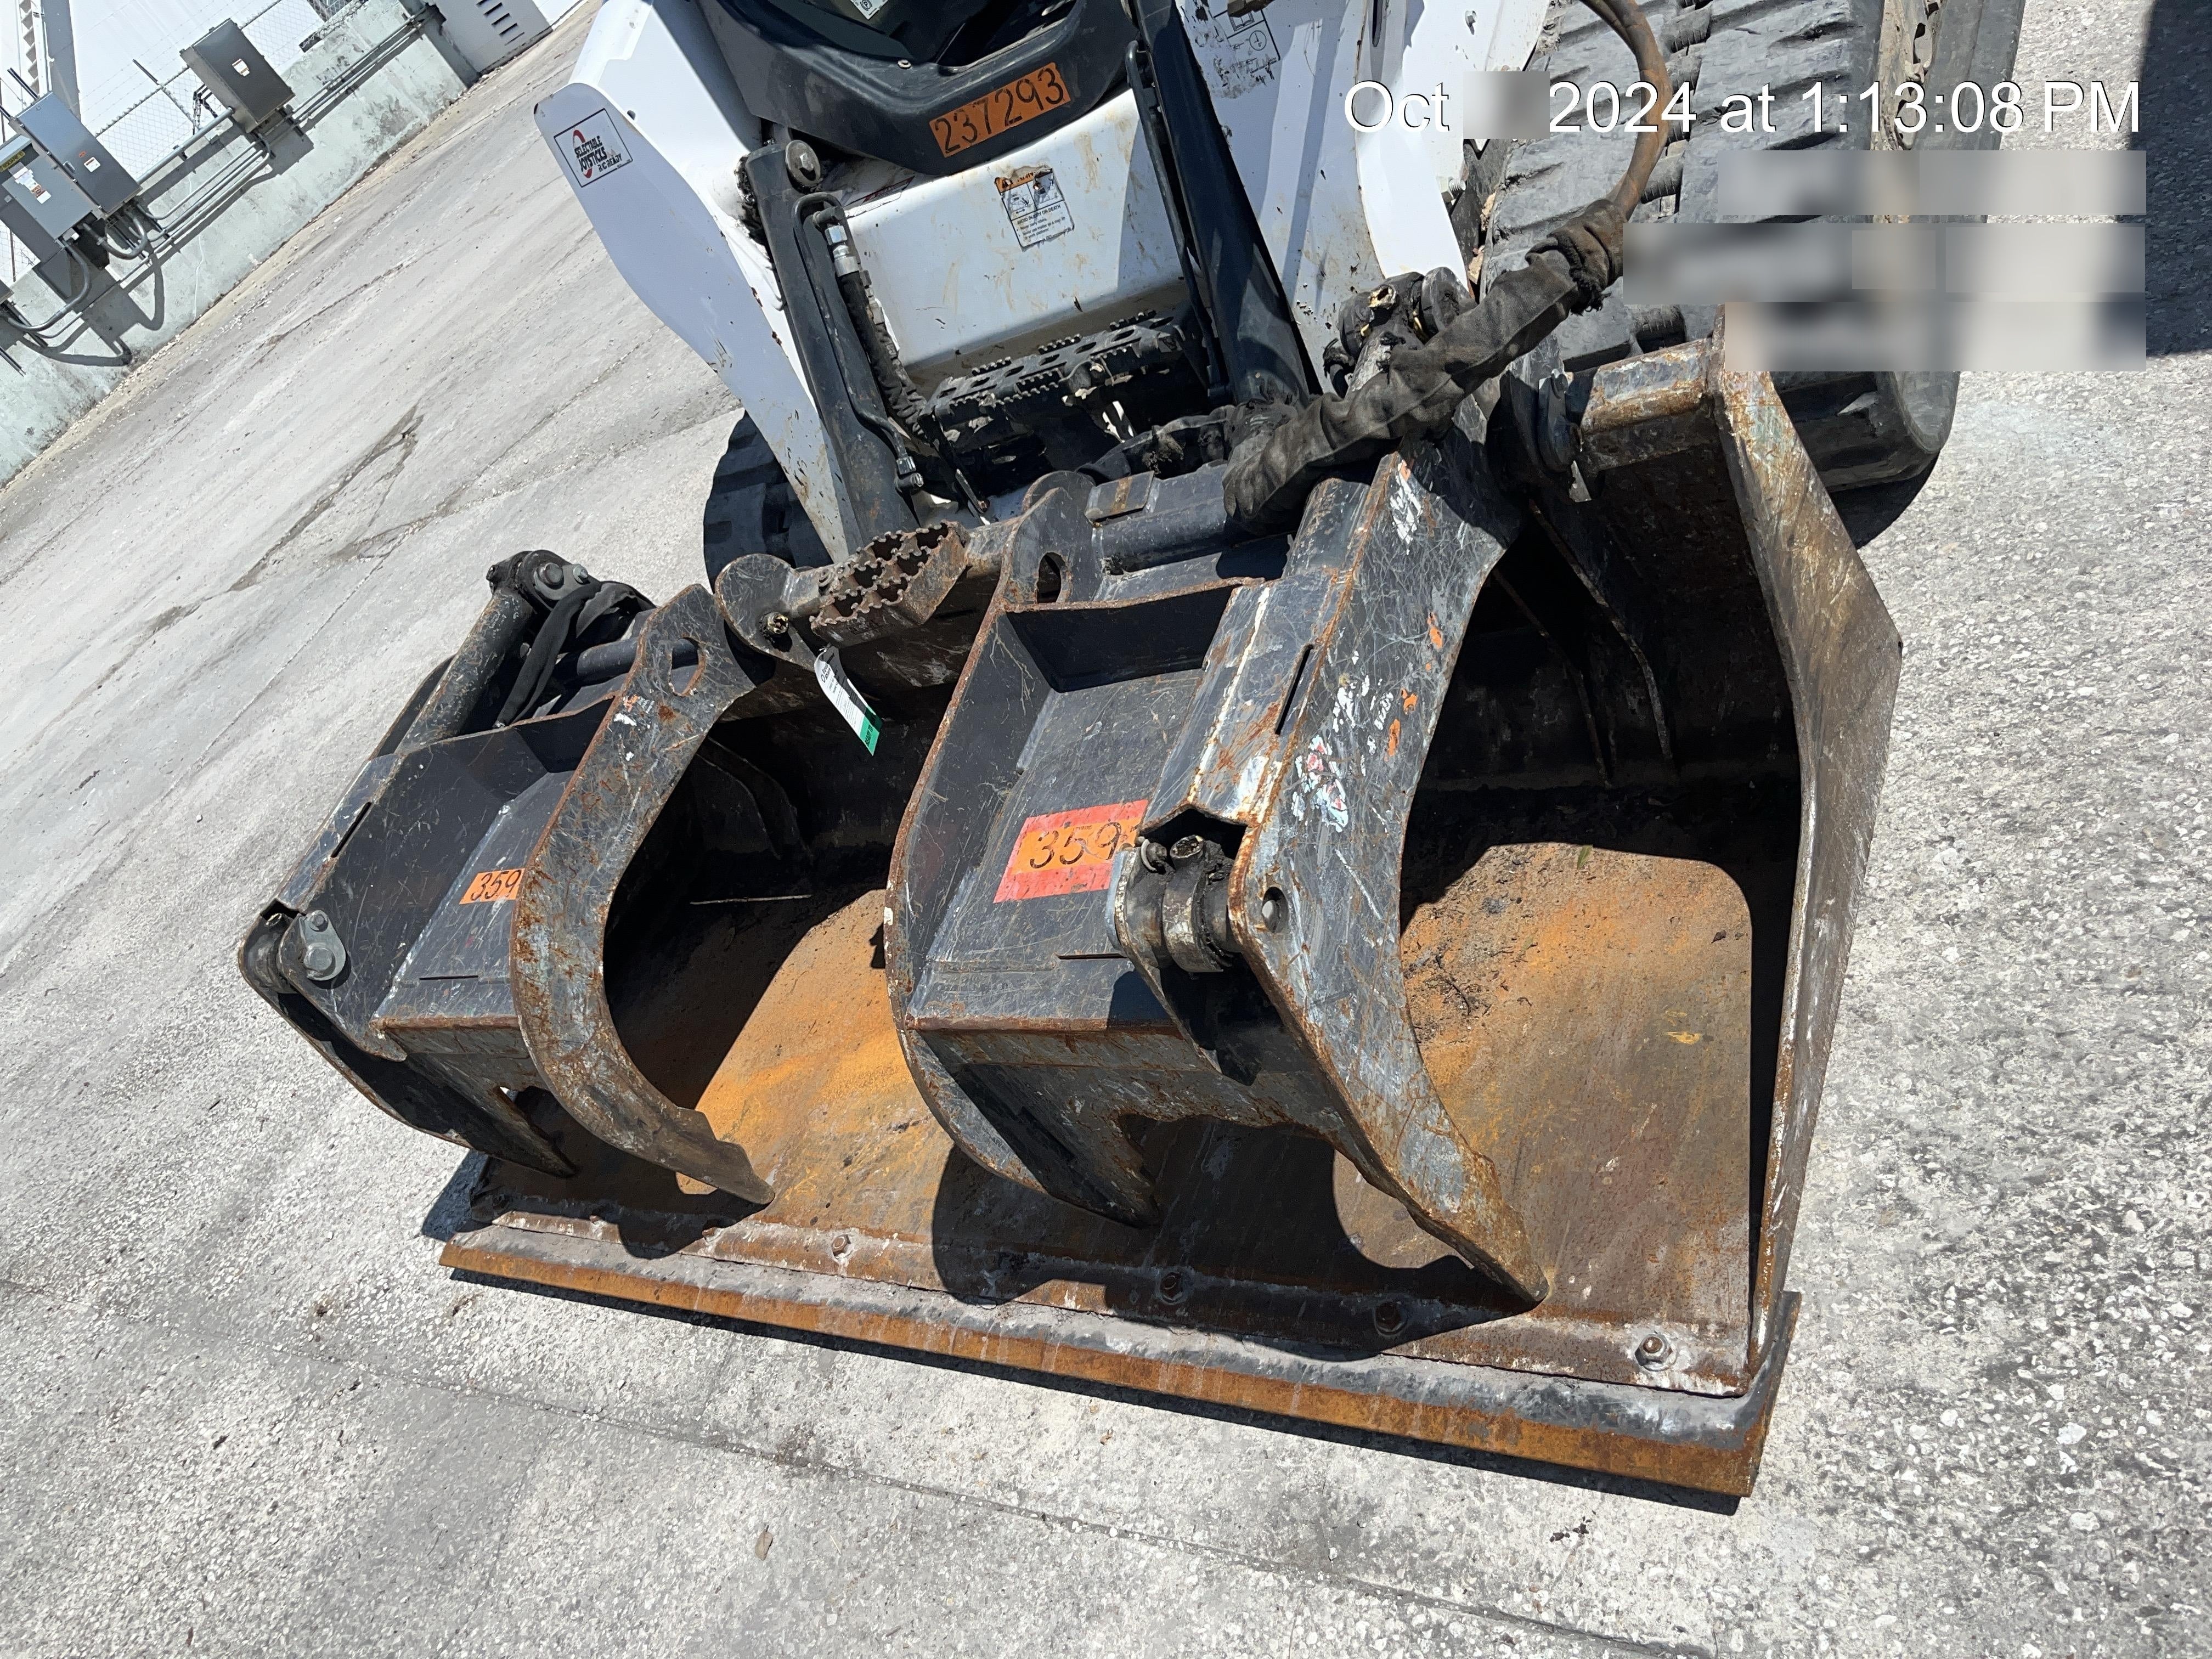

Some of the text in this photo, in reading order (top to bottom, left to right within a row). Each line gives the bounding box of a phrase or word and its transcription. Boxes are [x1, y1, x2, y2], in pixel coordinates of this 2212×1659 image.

[935, 67, 1064, 154] 237293
[574, 136, 603, 159] SELECTABLE
[578, 146, 607, 172] JOYSTICKS
[606, 153, 622, 167] READY
[1048, 204, 1061, 212] DEATH
[470, 870, 522, 901] 359
